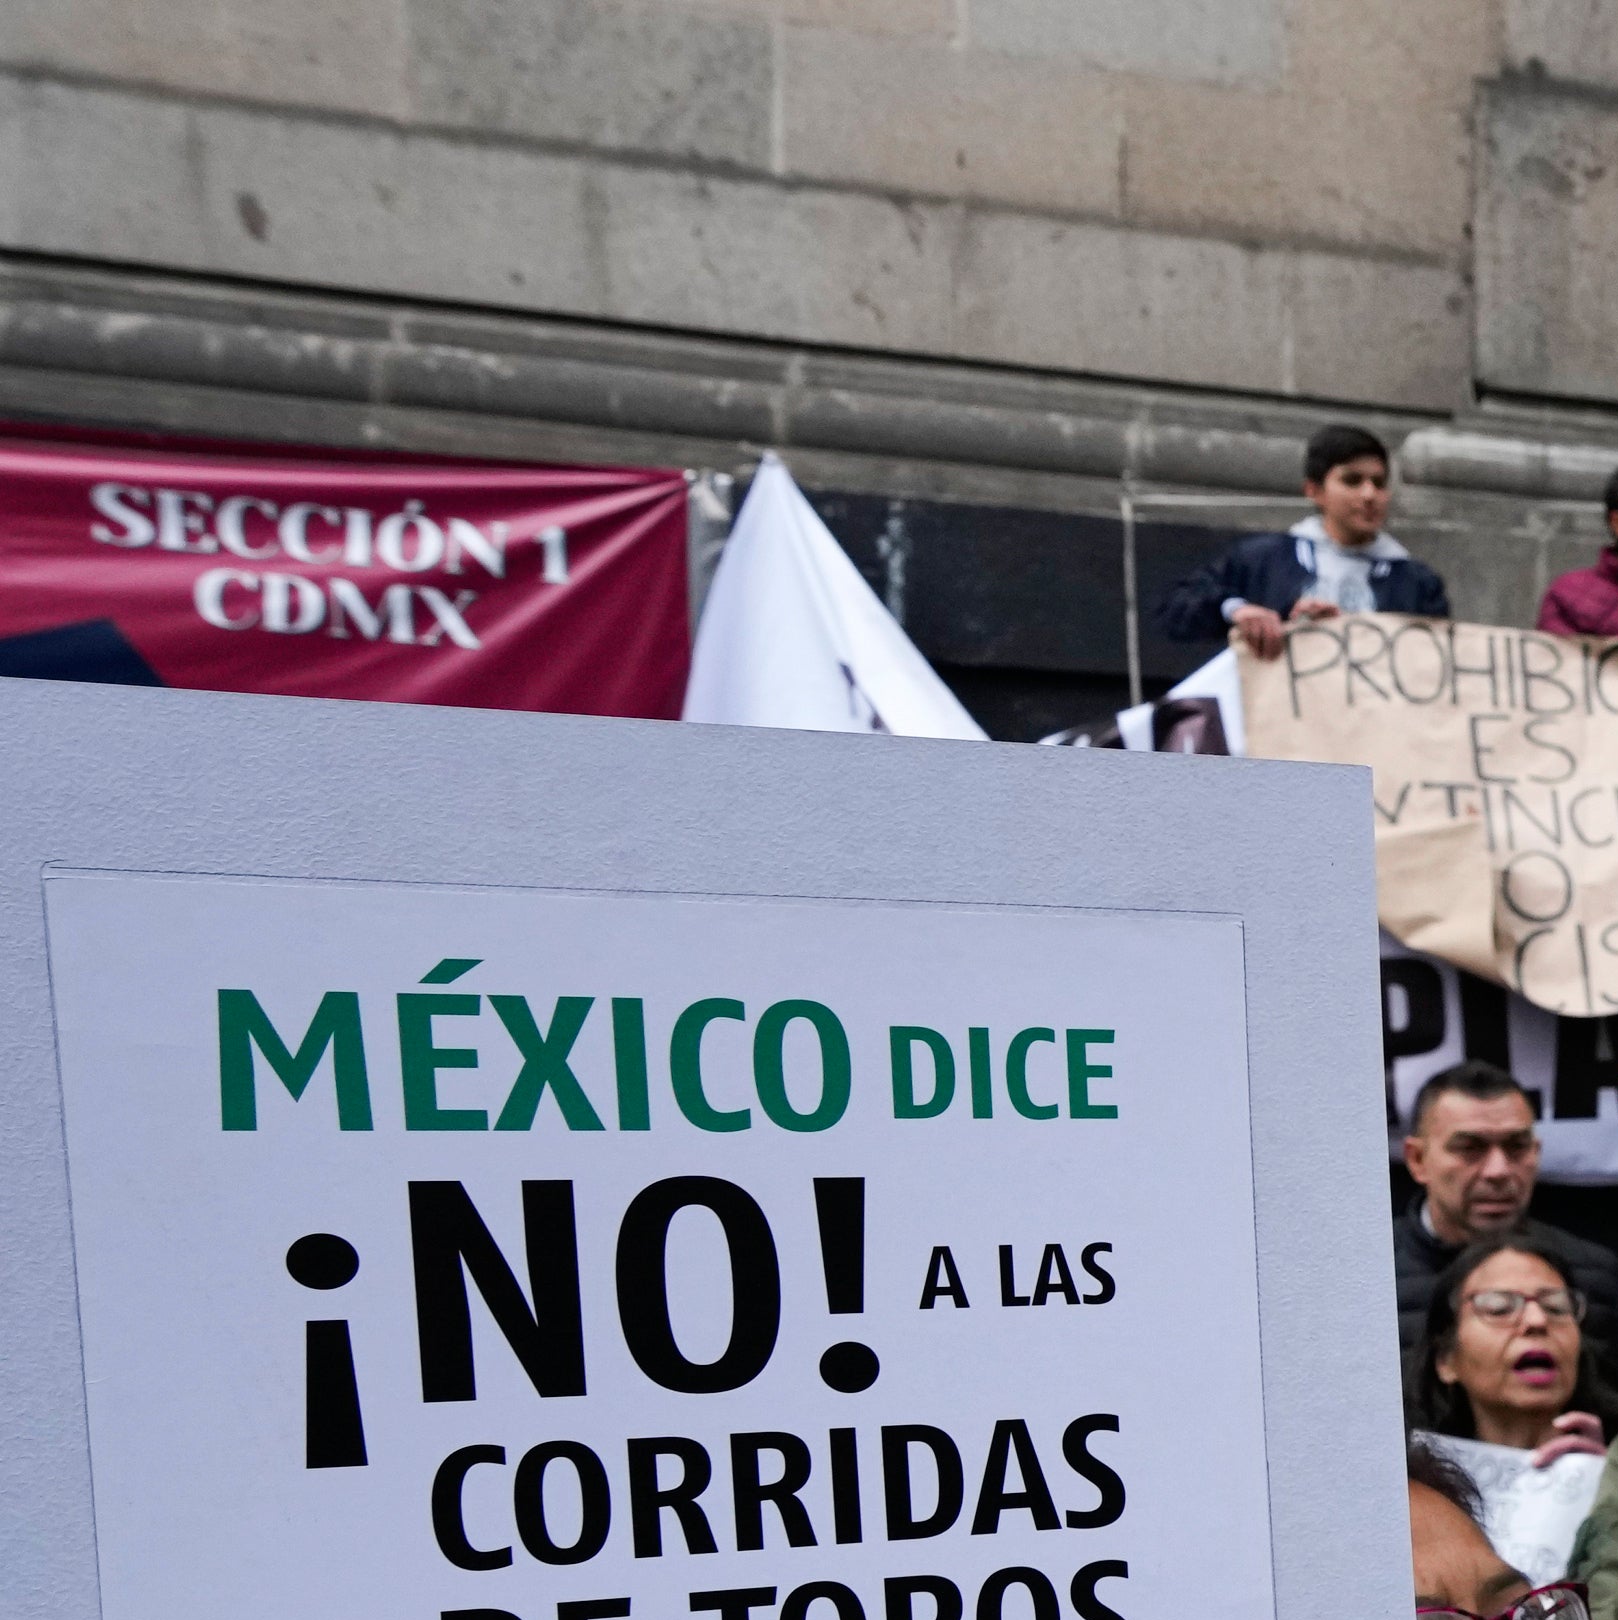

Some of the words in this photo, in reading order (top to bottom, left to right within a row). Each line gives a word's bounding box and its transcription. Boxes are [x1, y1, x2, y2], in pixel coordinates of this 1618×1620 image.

[90, 481, 508, 579] SECCIÓN
[535, 524, 571, 585] 1
[193, 567, 484, 651] CDMX
[1470, 713, 1578, 784] ES
[216, 958, 853, 1133] MÉXICO
[891, 1026, 1119, 1120] DICE
[285, 1174, 881, 1470] ¡NO!
[918, 1245, 970, 1311] A
[999, 1241, 1117, 1308] LAS
[430, 1412, 1127, 1572] CORRIDAS
